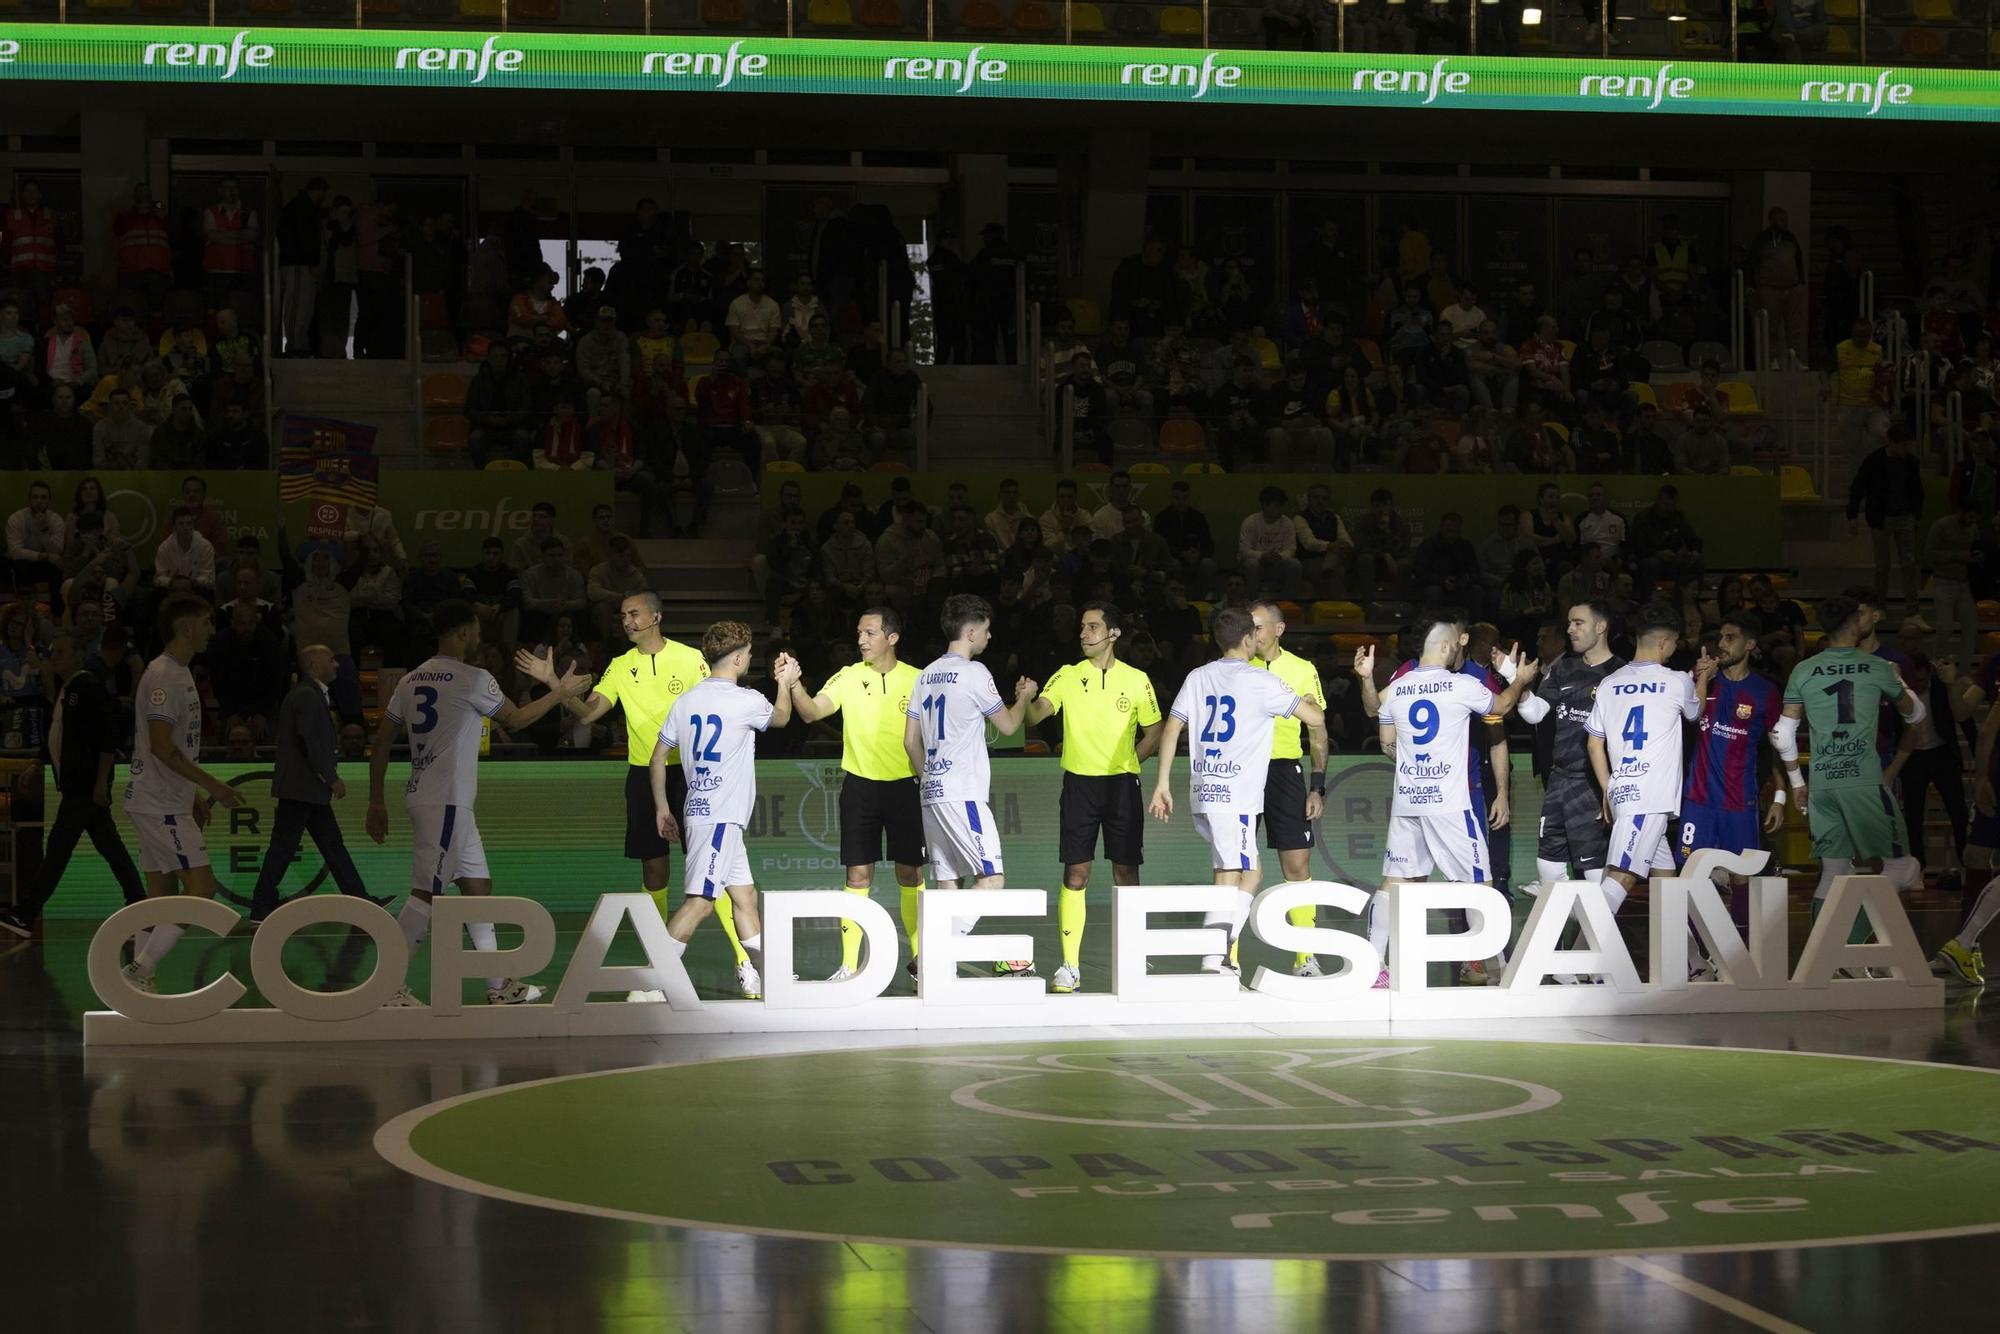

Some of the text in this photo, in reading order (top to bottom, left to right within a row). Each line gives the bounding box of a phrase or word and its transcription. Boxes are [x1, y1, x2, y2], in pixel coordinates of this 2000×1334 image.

[143, 31, 274, 79] renfe
[395, 36, 523, 82] renfe
[642, 40, 767, 88] renfe
[884, 46, 1007, 99] renfe
[1121, 52, 1240, 98] renfe
[1353, 58, 1470, 104] renfe
[1579, 64, 1694, 109] renfe
[1801, 70, 1912, 115] renfe
[415, 497, 533, 538] renfe
[927, 672, 959, 685] LARRAYOZ
[1822, 679, 1856, 724] 1
[411, 686, 438, 734] 3
[922, 693, 946, 740] 11
[1200, 695, 1236, 742] 23
[1408, 699, 1440, 745] 9
[1622, 704, 1649, 750] 4
[690, 714, 723, 762] 22
[1203, 783, 1231, 793] GLOBAL
[1399, 784, 1442, 795] SCAN GLOBAL
[1409, 794, 1443, 804] LOGISTICS
[1682, 822, 1696, 845] 8
[87, 849, 1936, 1023] COPA DE ESPAÑA
[766, 1127, 2000, 1186] COPA DE ESPAÑA
[1549, 1164, 1878, 1183] SALA
[1230, 1189, 1810, 1229] renfe
